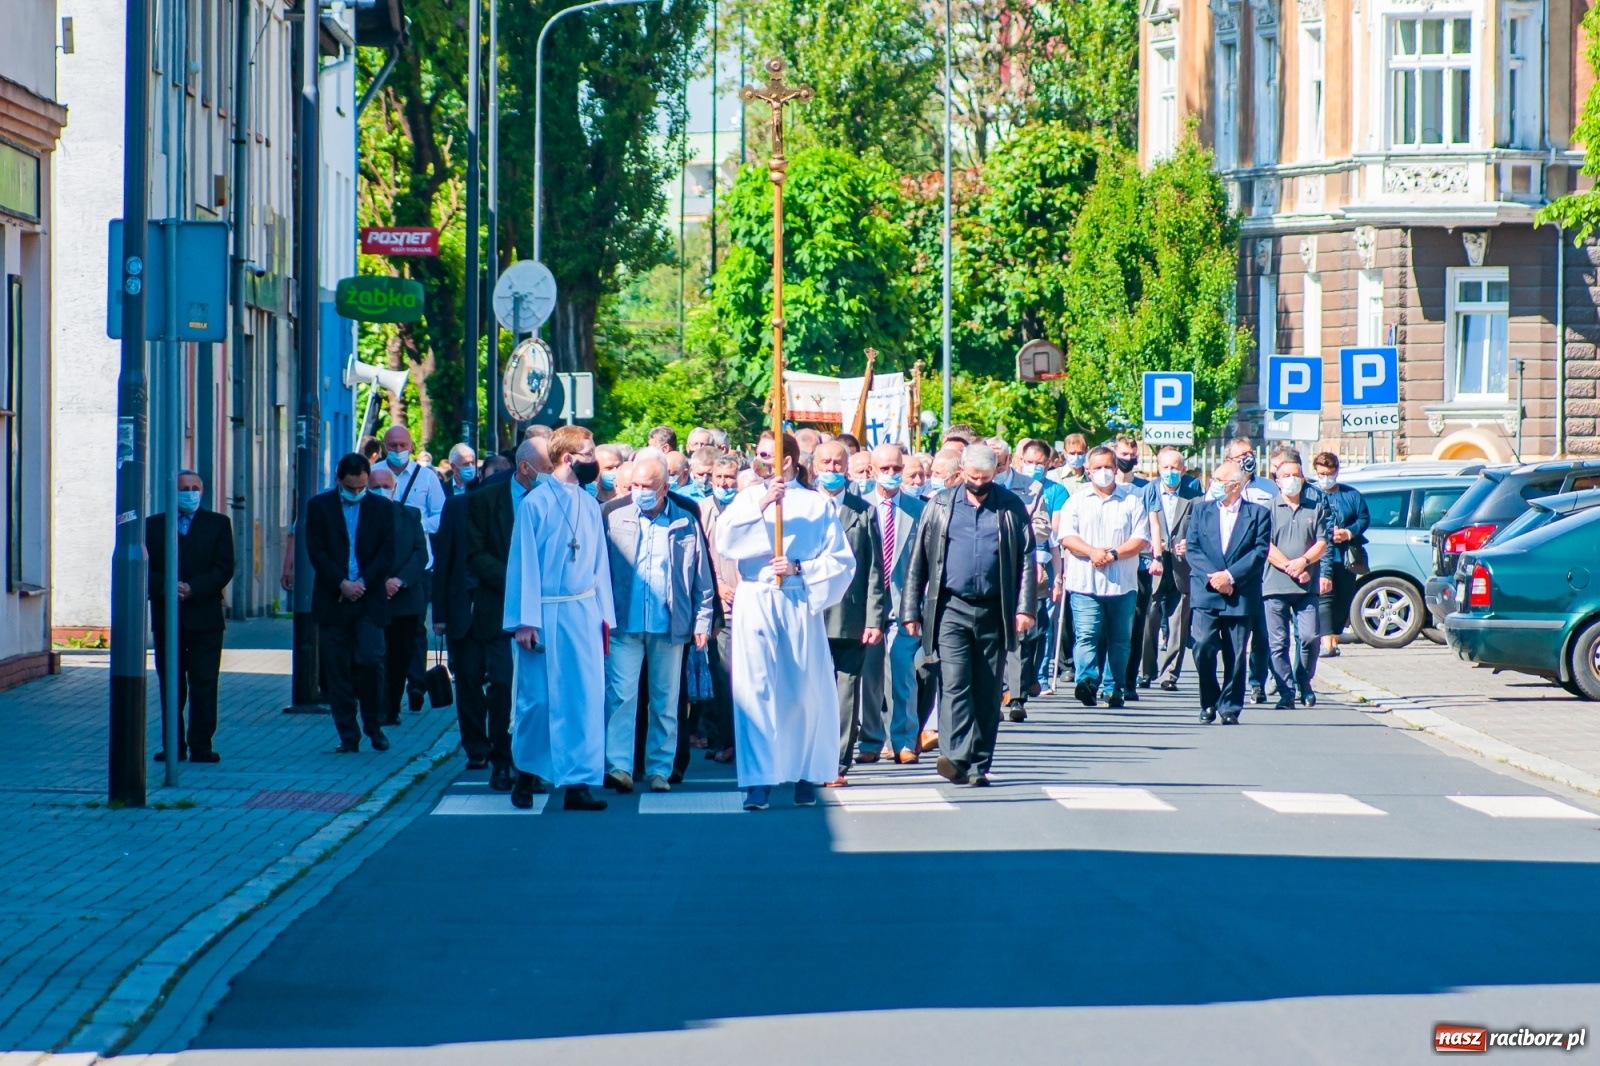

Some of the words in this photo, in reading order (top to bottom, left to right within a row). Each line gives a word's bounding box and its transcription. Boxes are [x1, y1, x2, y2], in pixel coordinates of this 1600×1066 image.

[367, 231, 432, 246] POSNET
[346, 285, 417, 308] żabka
[1279, 362, 1311, 405] P
[1352, 353, 1386, 400] P
[1153, 377, 1183, 417] P
[1342, 411, 1398, 427] Koniec
[1144, 427, 1193, 439] Koniec
